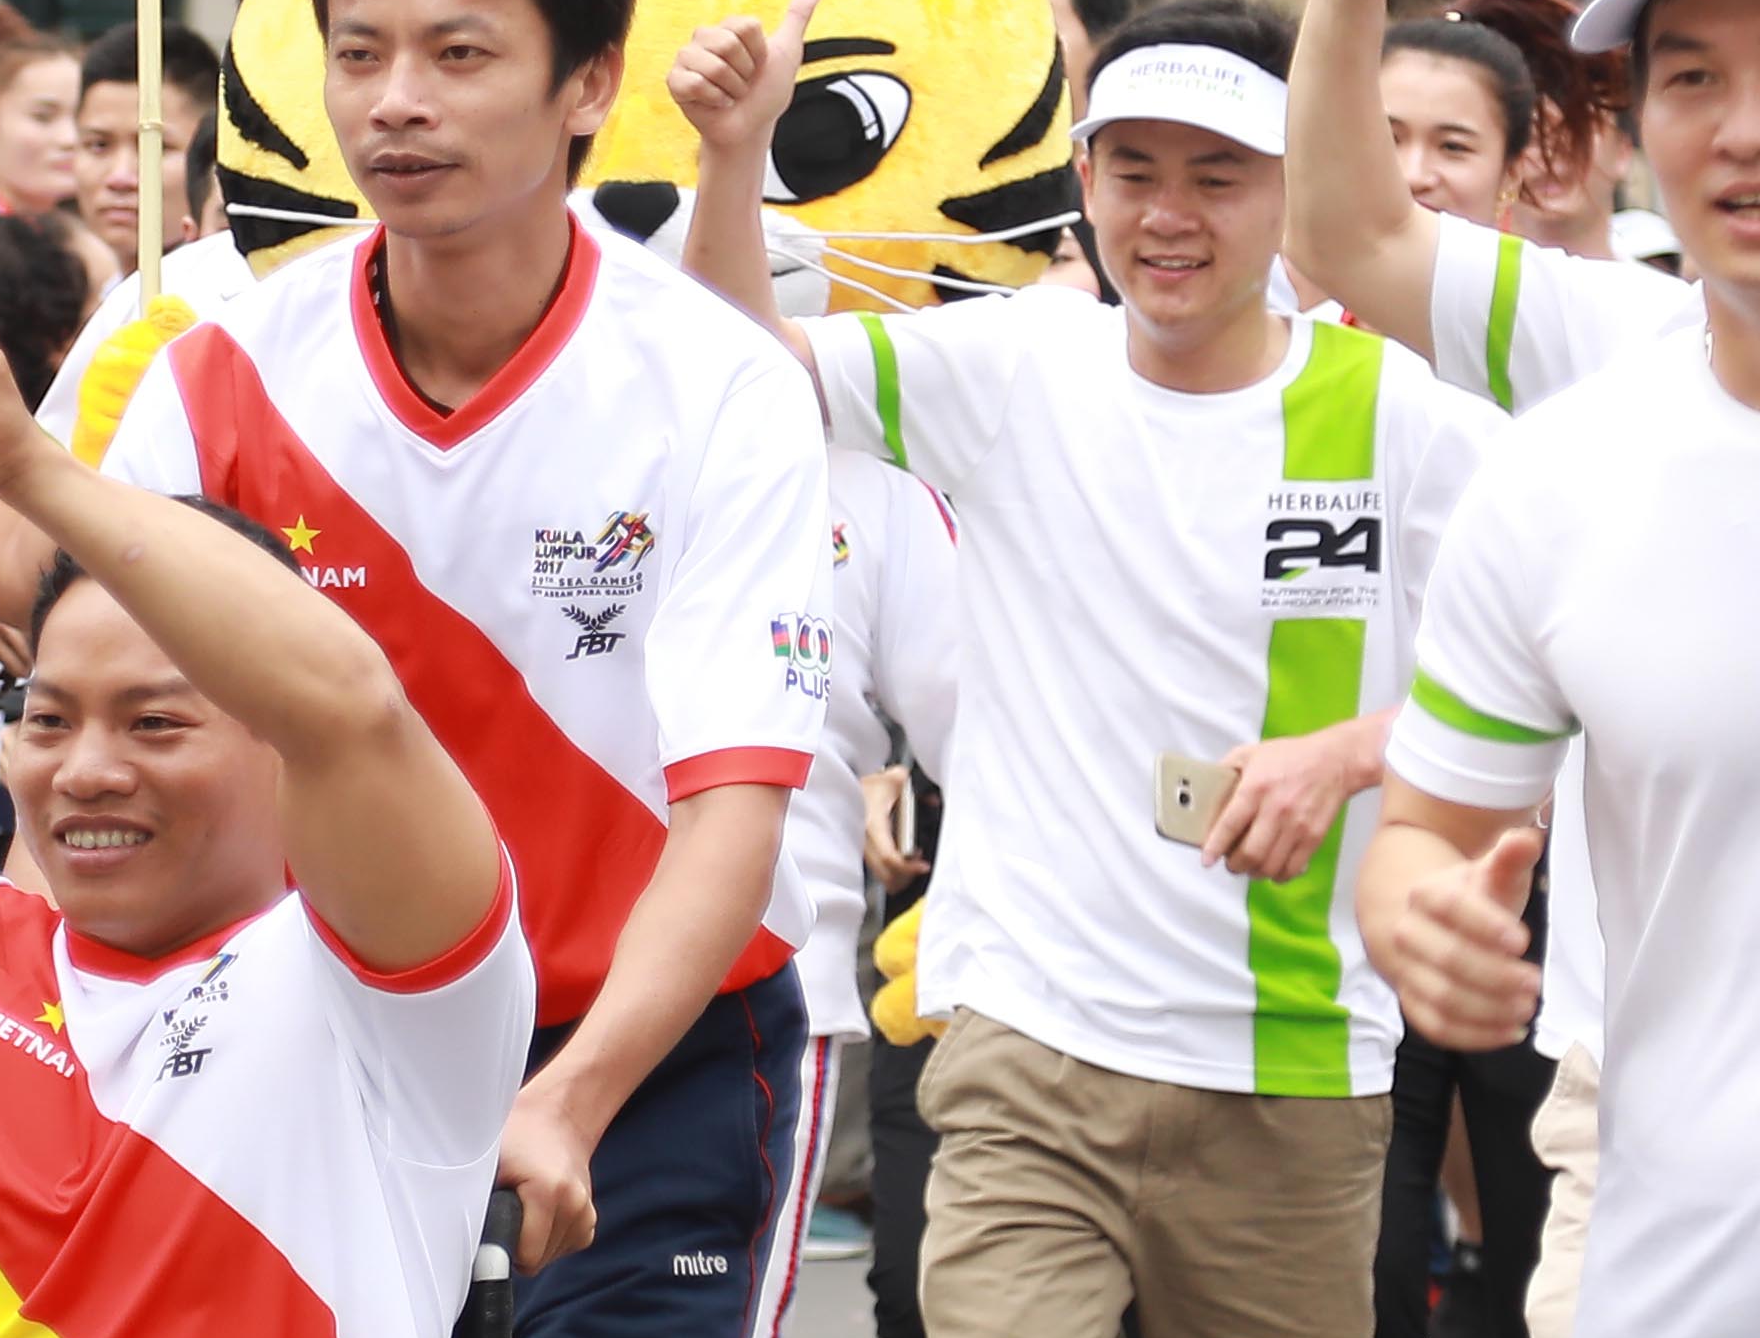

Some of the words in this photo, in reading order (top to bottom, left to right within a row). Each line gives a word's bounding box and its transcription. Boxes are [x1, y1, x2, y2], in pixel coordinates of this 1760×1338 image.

[1268, 491, 1382, 511] HERBALIFE
[535, 529, 585, 545] KUALA
[535, 545, 598, 561] LUMPUR
[1264, 516, 1382, 581] 24
[534, 560, 564, 575] 2017
[559, 577, 584, 587] SEA
[590, 576, 634, 586] GAMES
[576, 589, 602, 597] PARA
[565, 633, 627, 660] FBT
[673, 1251, 728, 1276] mitre
